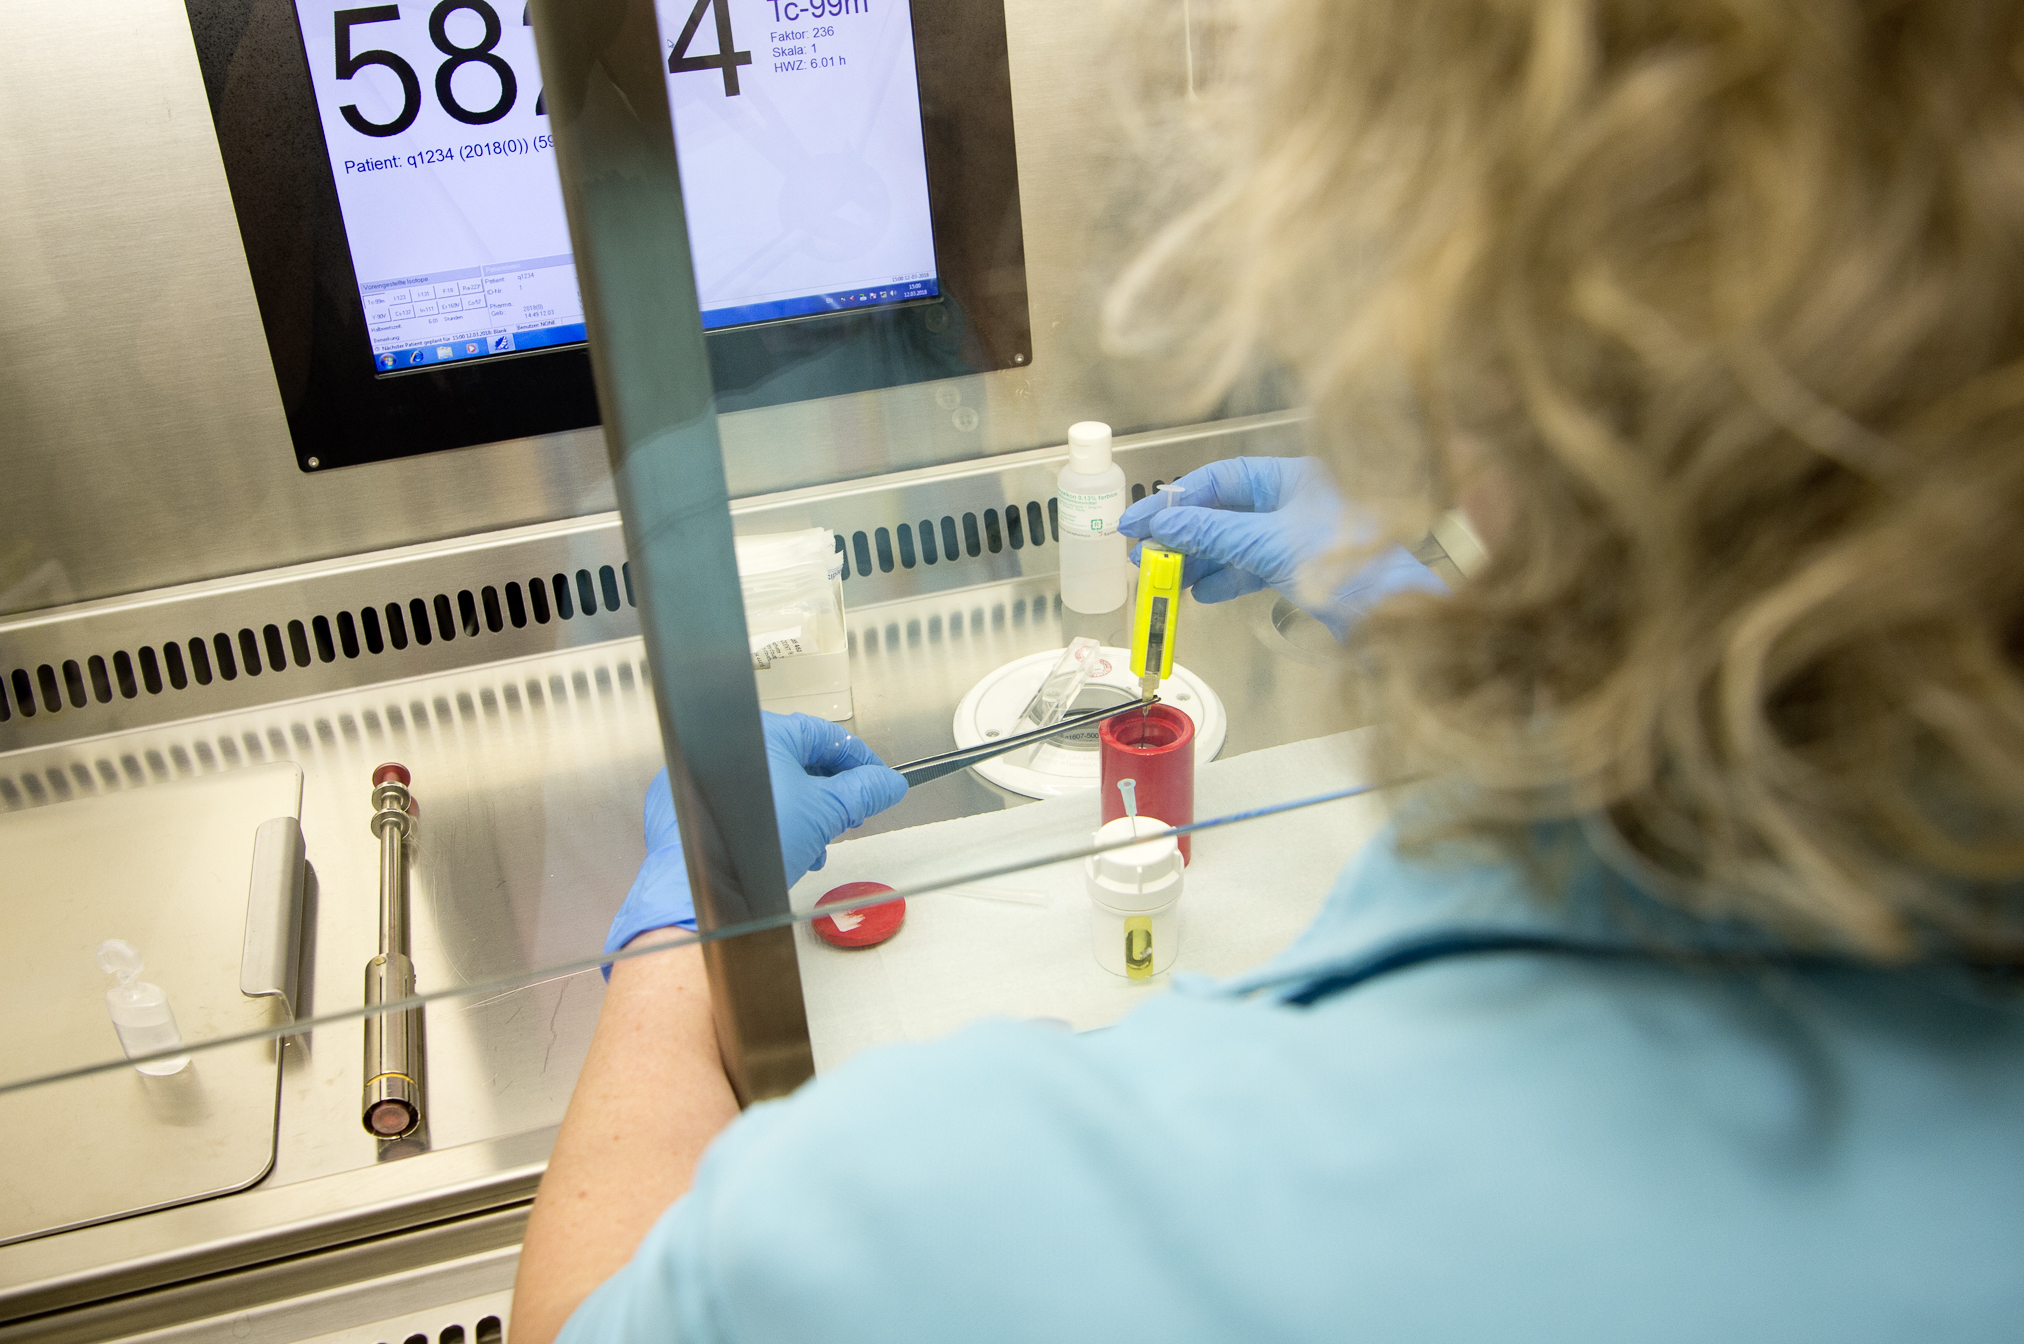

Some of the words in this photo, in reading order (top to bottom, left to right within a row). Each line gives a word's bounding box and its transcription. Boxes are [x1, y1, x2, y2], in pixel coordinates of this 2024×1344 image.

[766, 0, 868, 22] Tc-99m
[770, 30, 810, 43] Faktor:
[812, 26, 835, 38] 236
[772, 45, 807, 58] Skala:
[811, 43, 817, 53] 1
[334, 0, 548, 138] 58
[774, 59, 807, 73] HWZ:
[810, 56, 834, 69] 6.01
[838, 55, 846, 66] h
[344, 155, 402, 174] Patient:
[407, 147, 454, 168] q1234
[459, 138, 529, 162] (2018(0))
[517, 272, 534, 280] q1234
